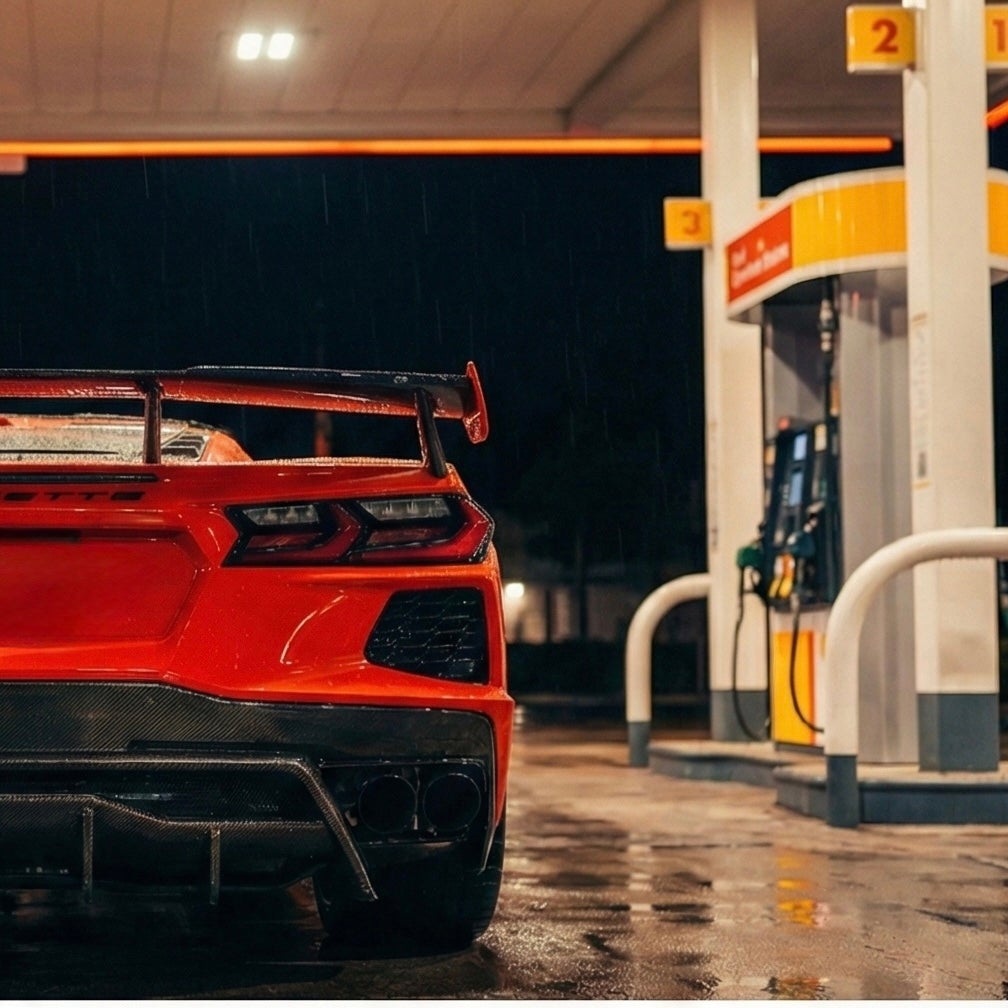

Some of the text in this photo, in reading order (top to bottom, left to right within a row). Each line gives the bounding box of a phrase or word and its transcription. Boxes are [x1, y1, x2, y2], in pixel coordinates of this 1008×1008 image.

[871, 18, 899, 54] 2
[992, 19, 1006, 52] 1
[681, 210, 701, 236] 3
